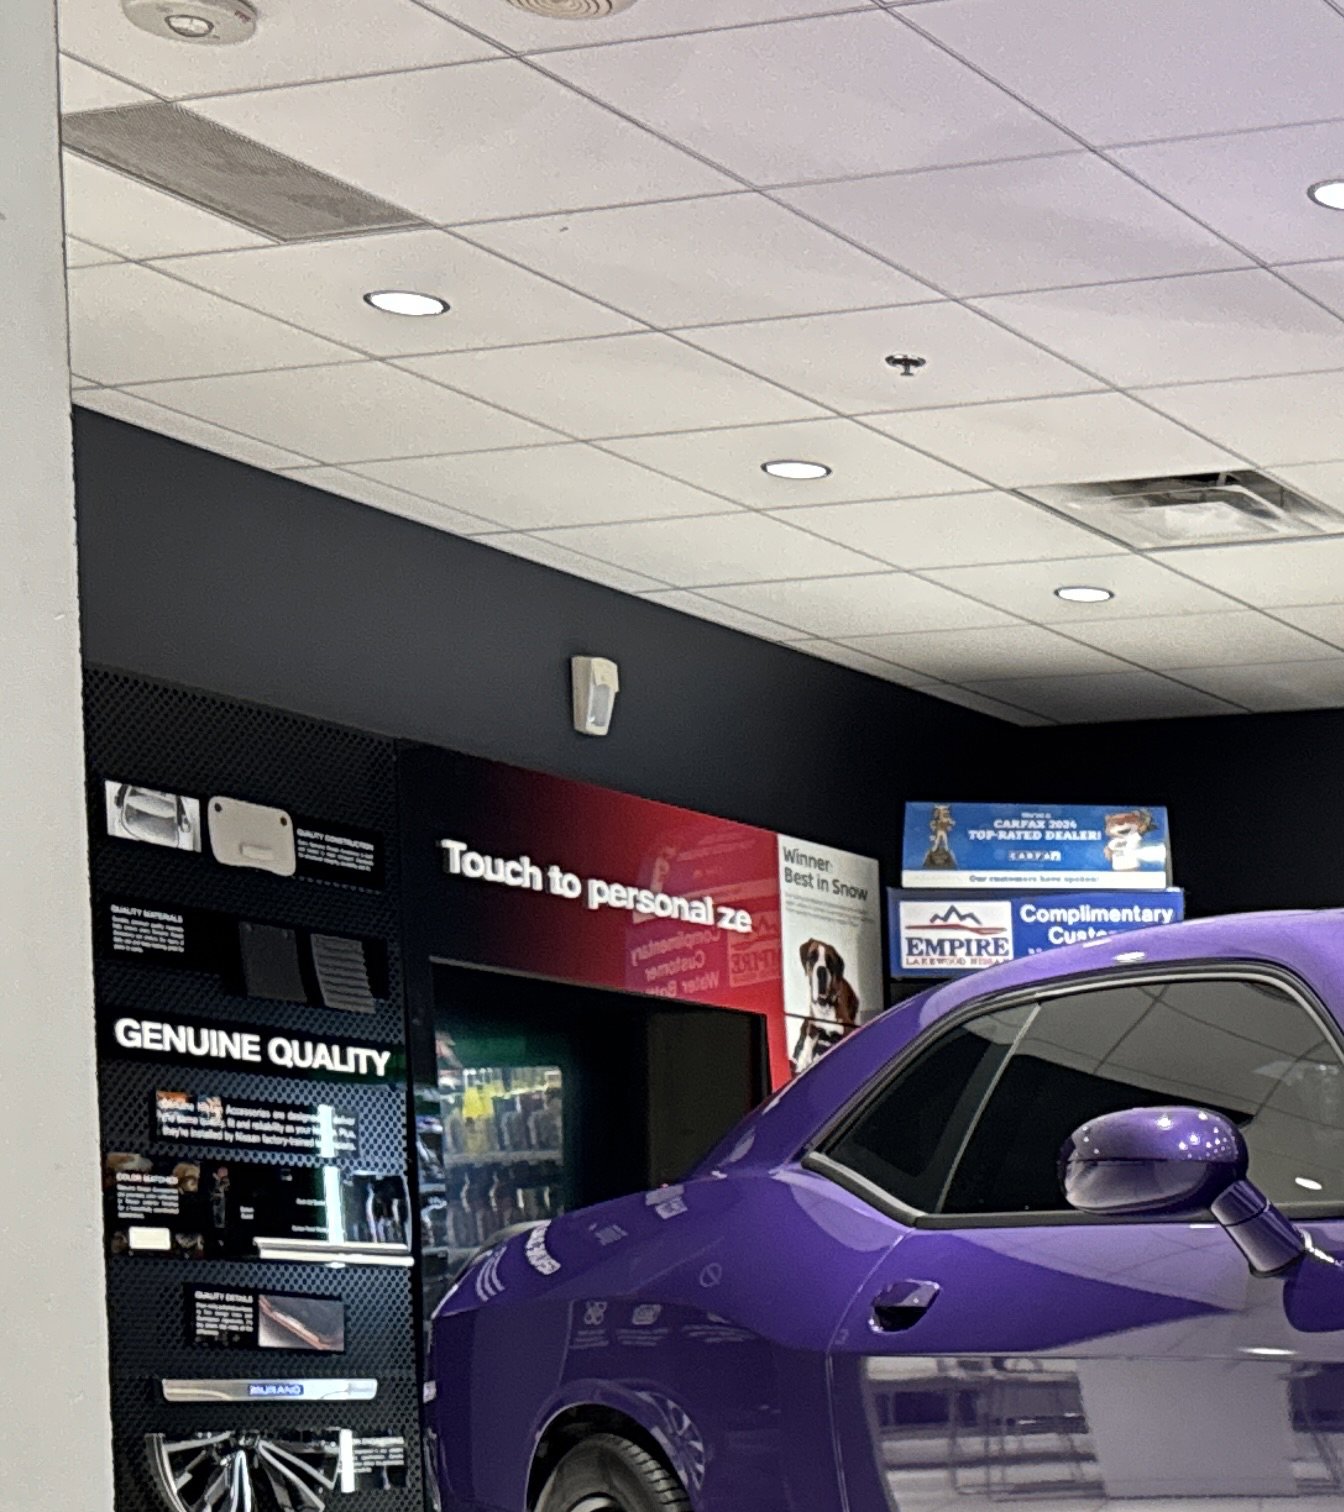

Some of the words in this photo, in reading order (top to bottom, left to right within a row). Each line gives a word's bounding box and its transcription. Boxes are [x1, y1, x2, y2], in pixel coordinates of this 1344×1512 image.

[968, 830, 1043, 841] TOP-RATED
[993, 820, 1046, 829] CARFAX
[1048, 820, 1078, 830] 2024
[441, 838, 544, 892] Touch
[547, 864, 582, 899] to
[783, 846, 831, 873] Winner
[784, 866, 814, 889] Best
[817, 873, 830, 893] in
[832, 878, 869, 902] Snow
[1020, 903, 1174, 924] Complimentary
[905, 937, 1010, 957] EMPIRE
[114, 1018, 262, 1063] GENUINE
[268, 1037, 392, 1077] QUALITY
